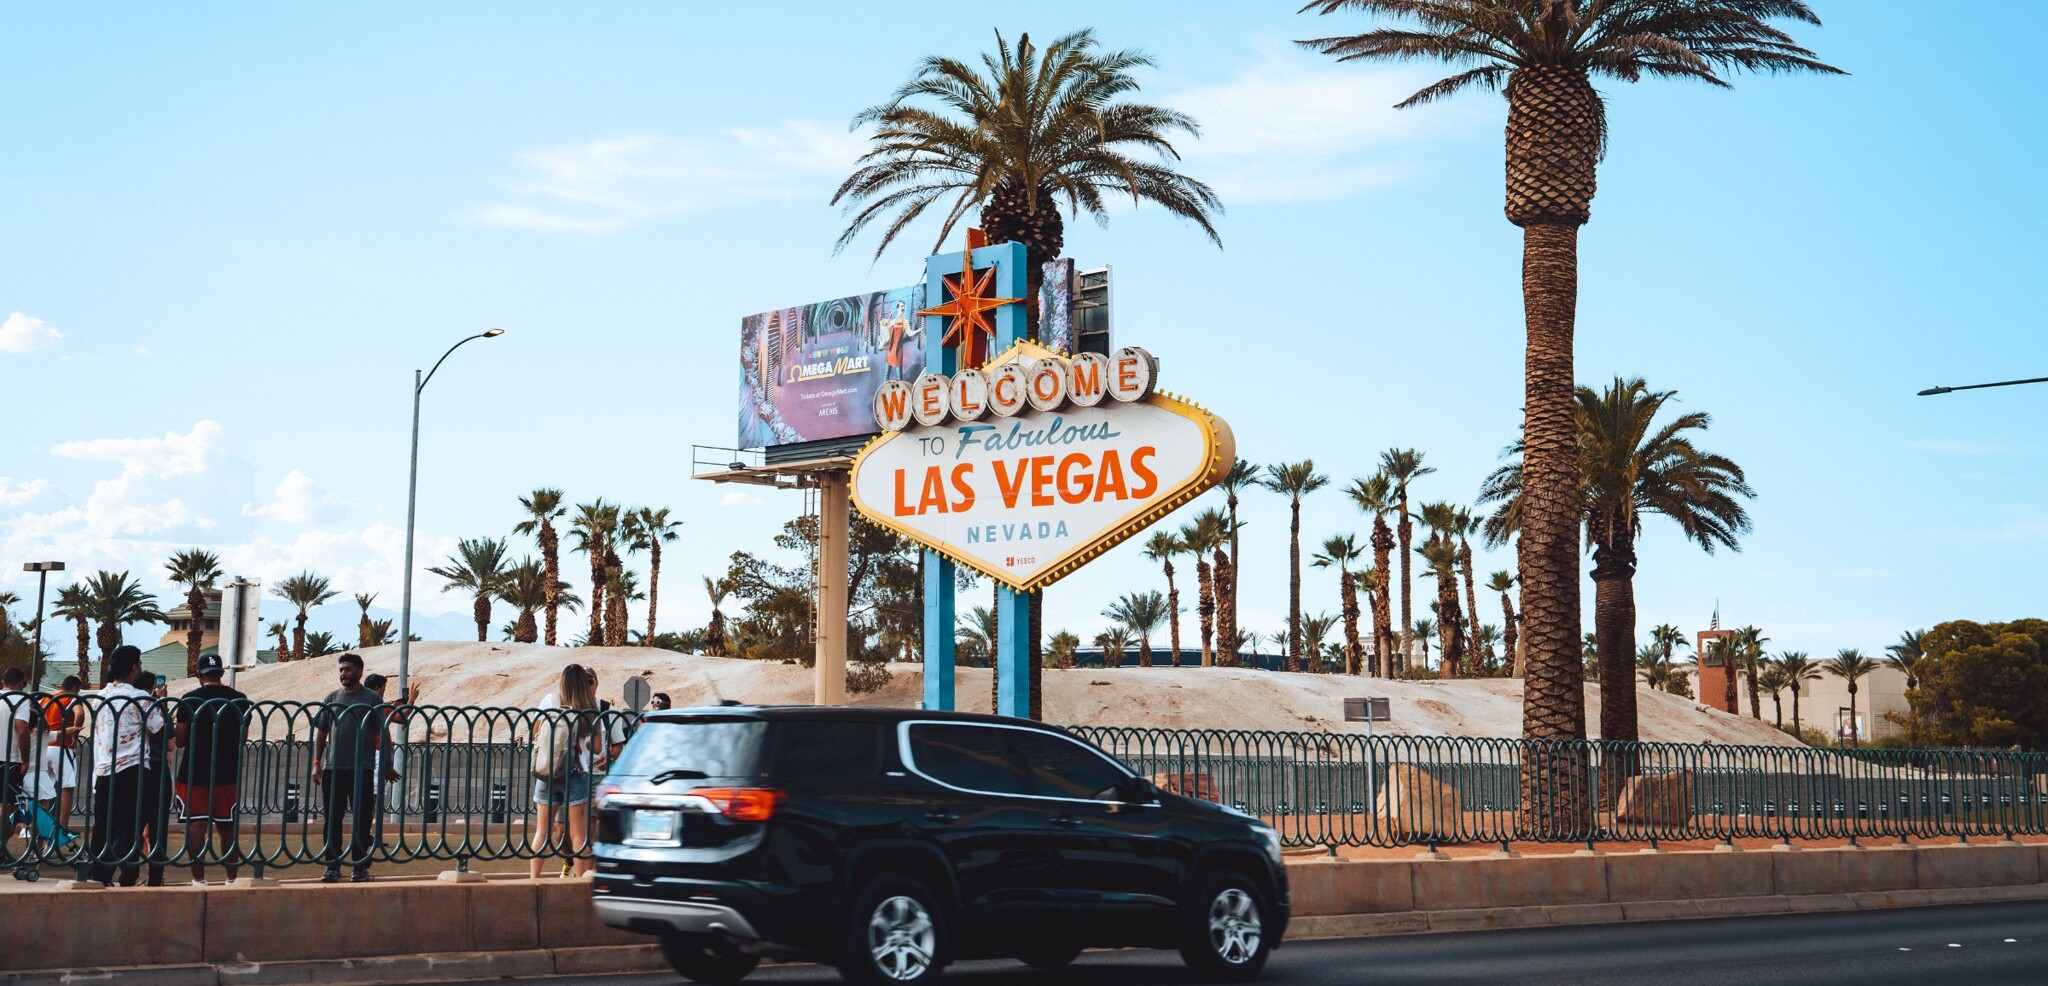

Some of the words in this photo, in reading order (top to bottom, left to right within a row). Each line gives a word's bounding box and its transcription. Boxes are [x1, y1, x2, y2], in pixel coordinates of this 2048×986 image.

[833, 356, 870, 375] MART
[800, 392, 815, 400] Tickets
[881, 358, 1138, 422] WELCOME
[919, 436, 945, 457] TO
[955, 416, 1121, 459] Fabulous
[893, 462, 975, 517] LAS
[991, 445, 1159, 509] VEGAS
[967, 519, 1069, 544] NEVADA
[1016, 556, 1035, 565] YESCO
